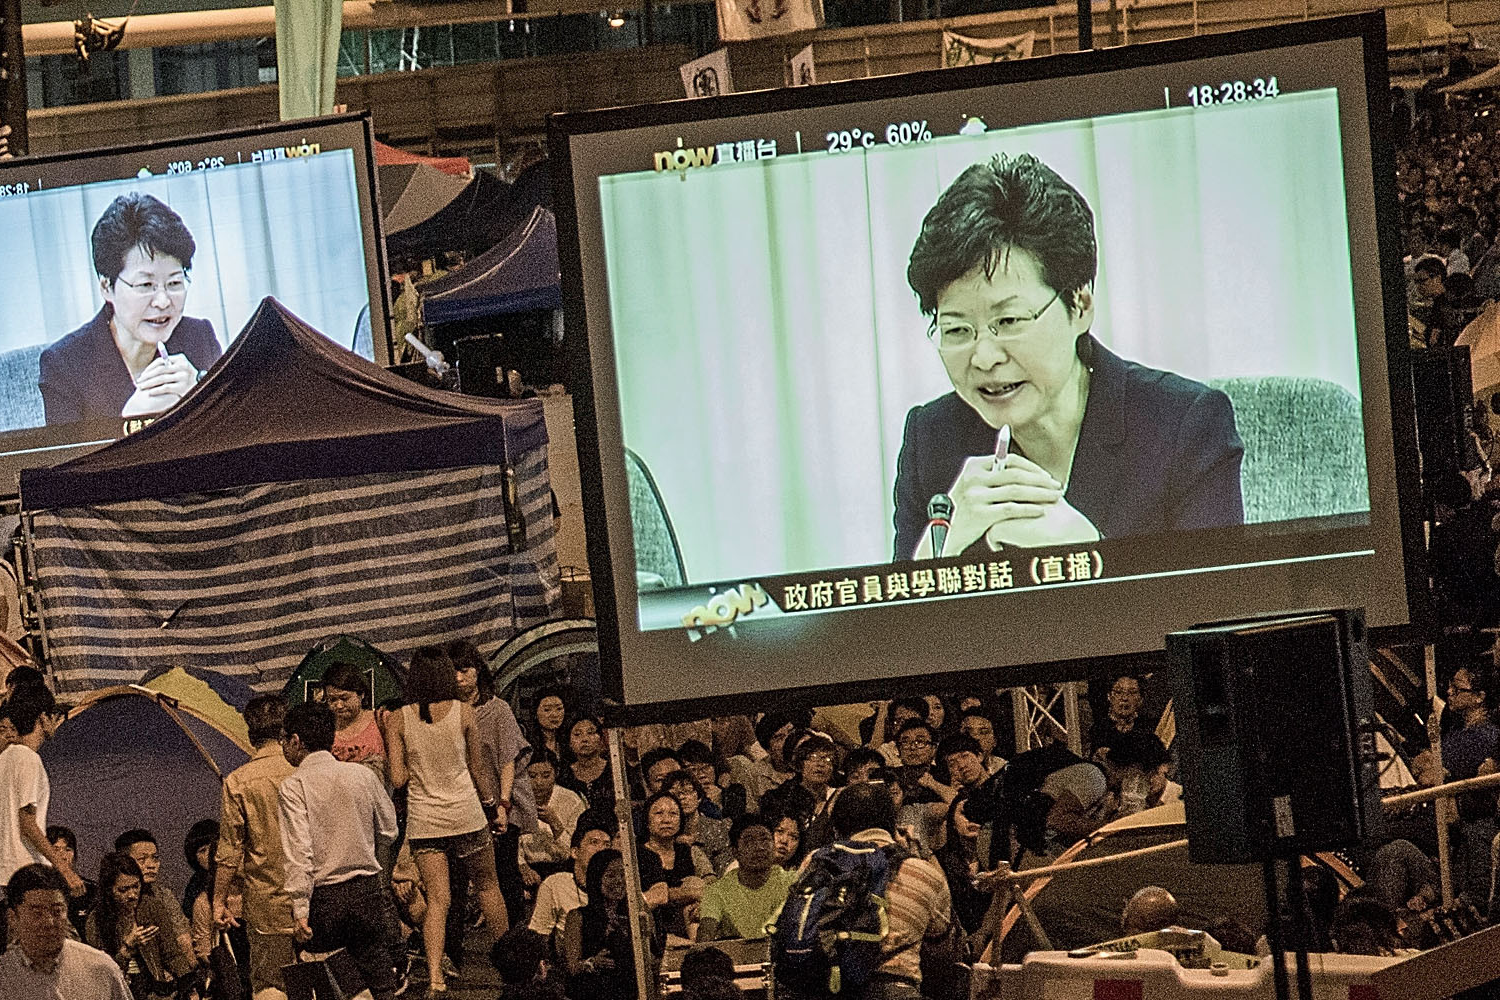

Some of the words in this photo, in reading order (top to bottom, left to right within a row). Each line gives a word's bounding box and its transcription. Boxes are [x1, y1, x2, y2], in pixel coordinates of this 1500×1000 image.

[654, 141, 715, 174] now
[885, 121, 933, 147] 60%
[1187, 76, 1280, 107] 18:28:34
[783, 561, 1014, 612] 政府官員與學聯對話
